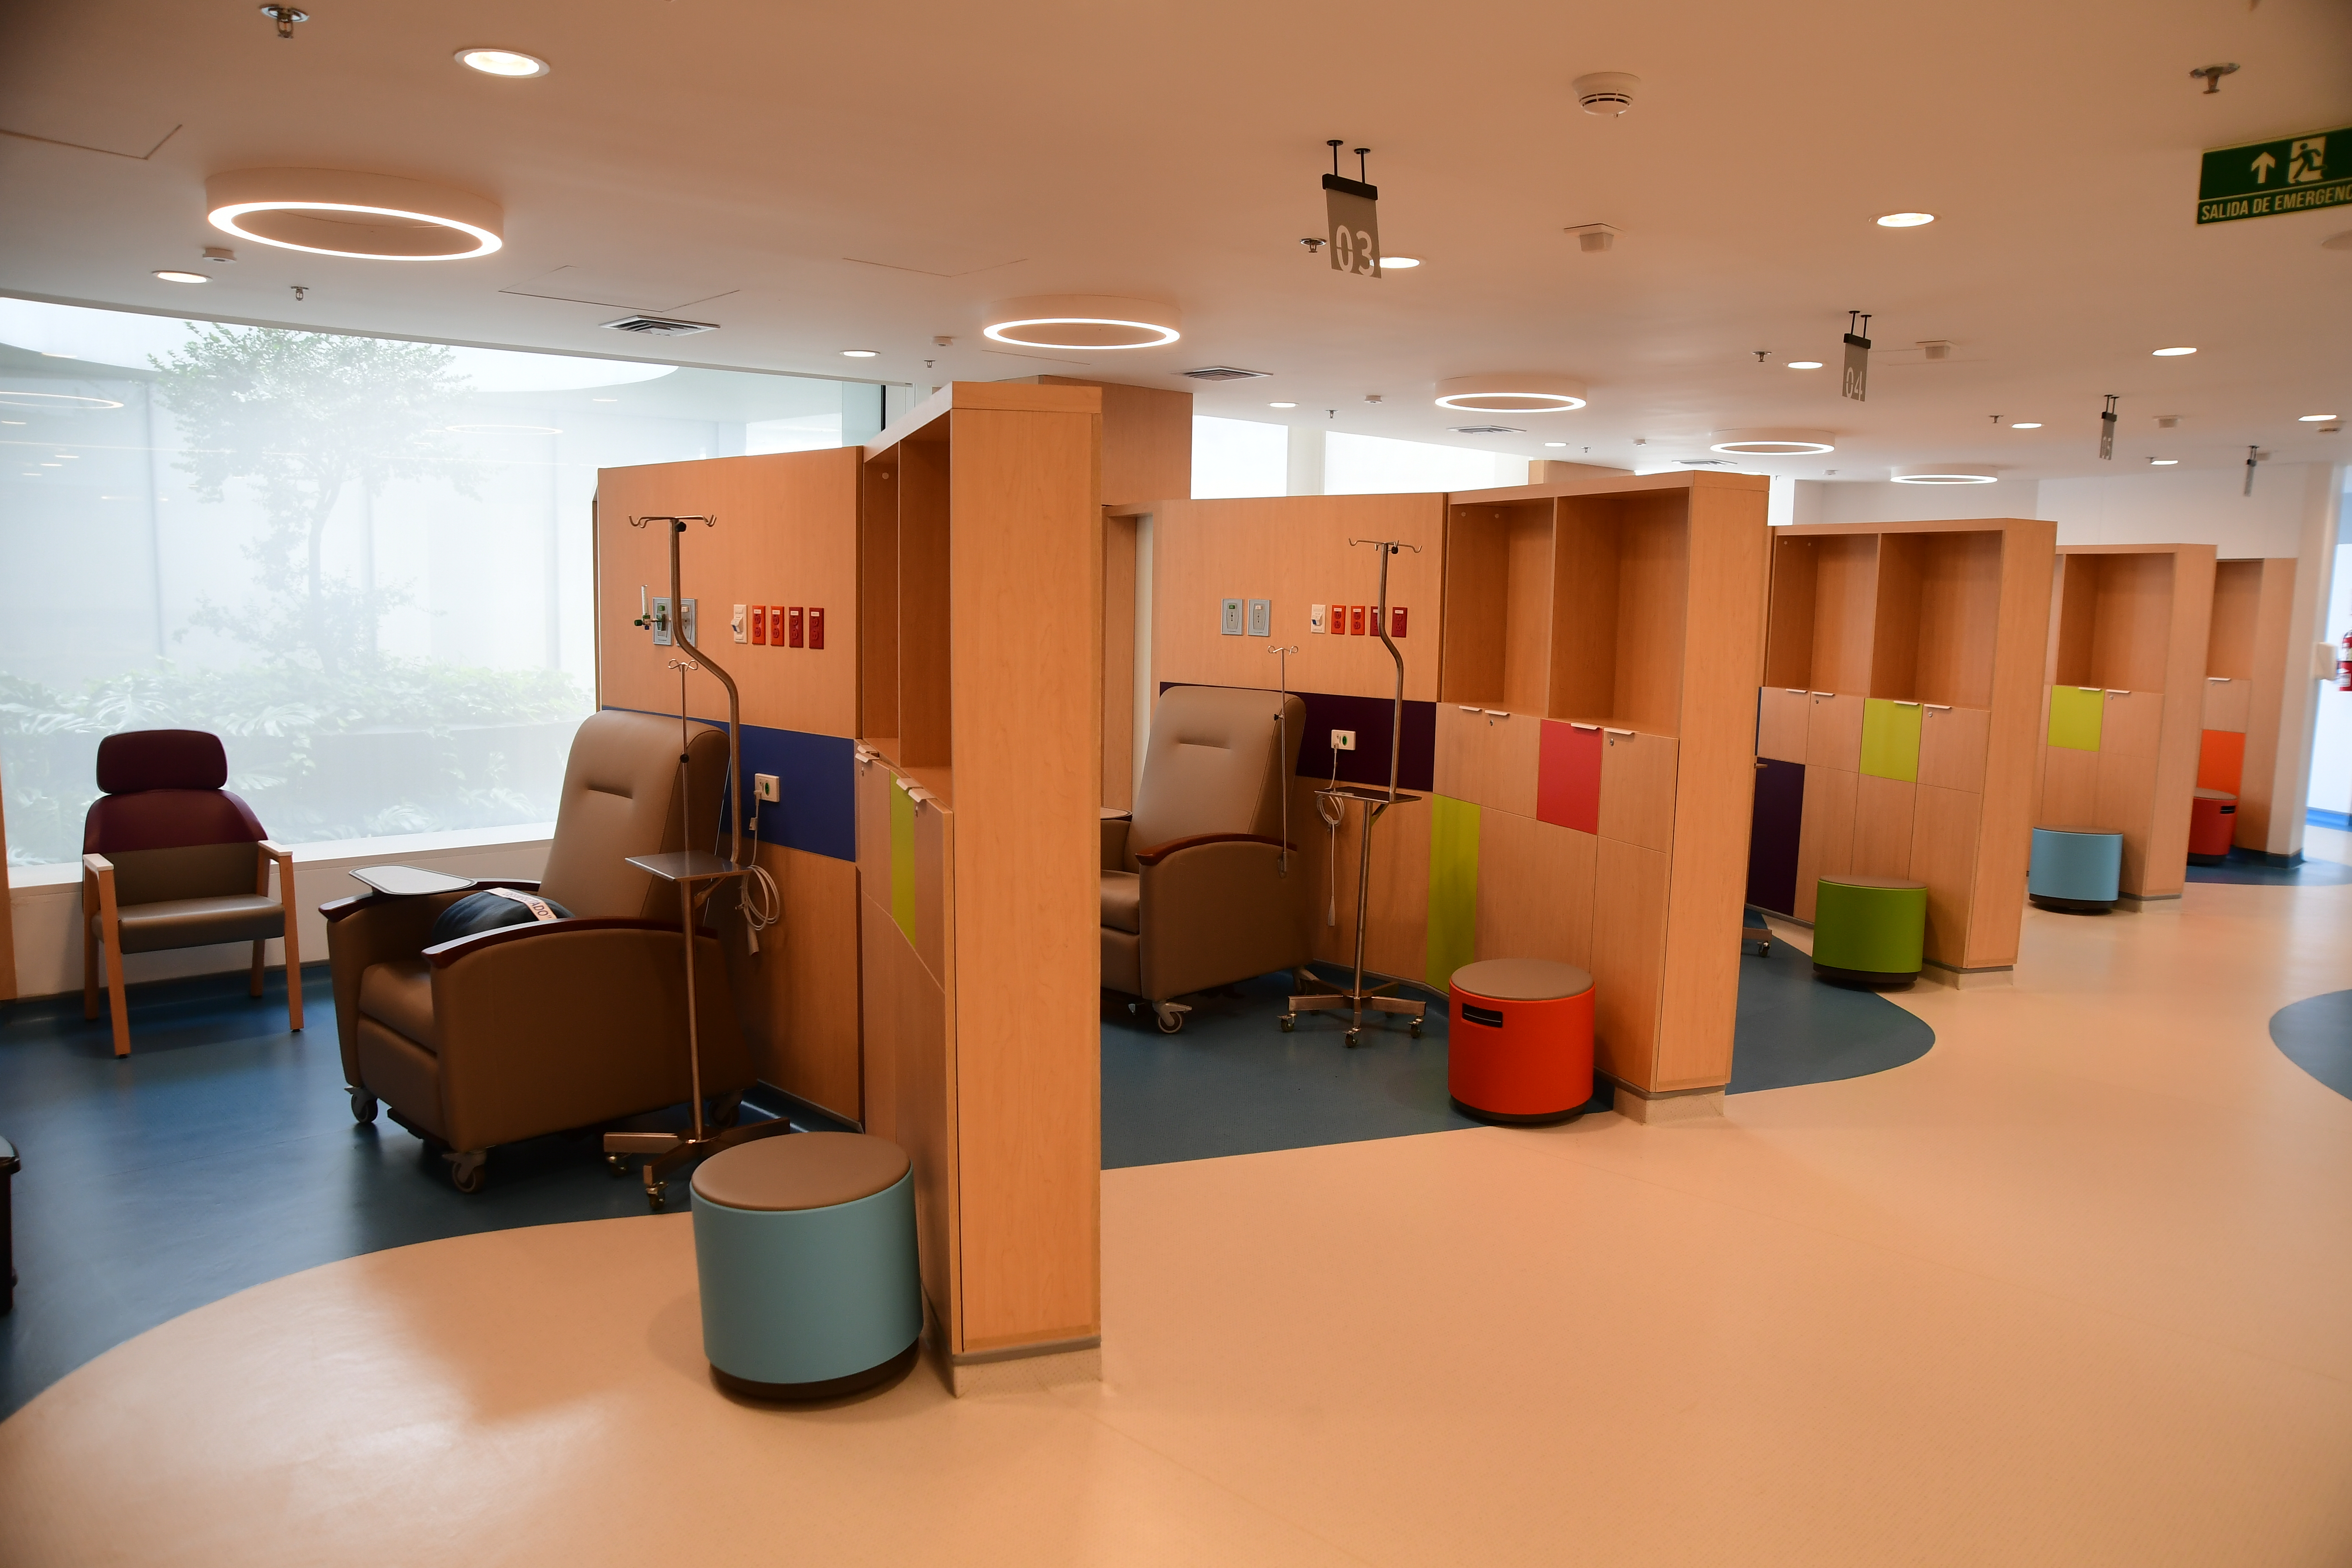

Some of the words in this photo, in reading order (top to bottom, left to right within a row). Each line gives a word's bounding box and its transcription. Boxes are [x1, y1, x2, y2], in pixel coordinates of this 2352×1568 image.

[2202, 200, 2249, 221] SALIDA
[2253, 196, 2271, 214] DE
[1336, 225, 1375, 277] 03
[1846, 367, 1863, 401] 04
